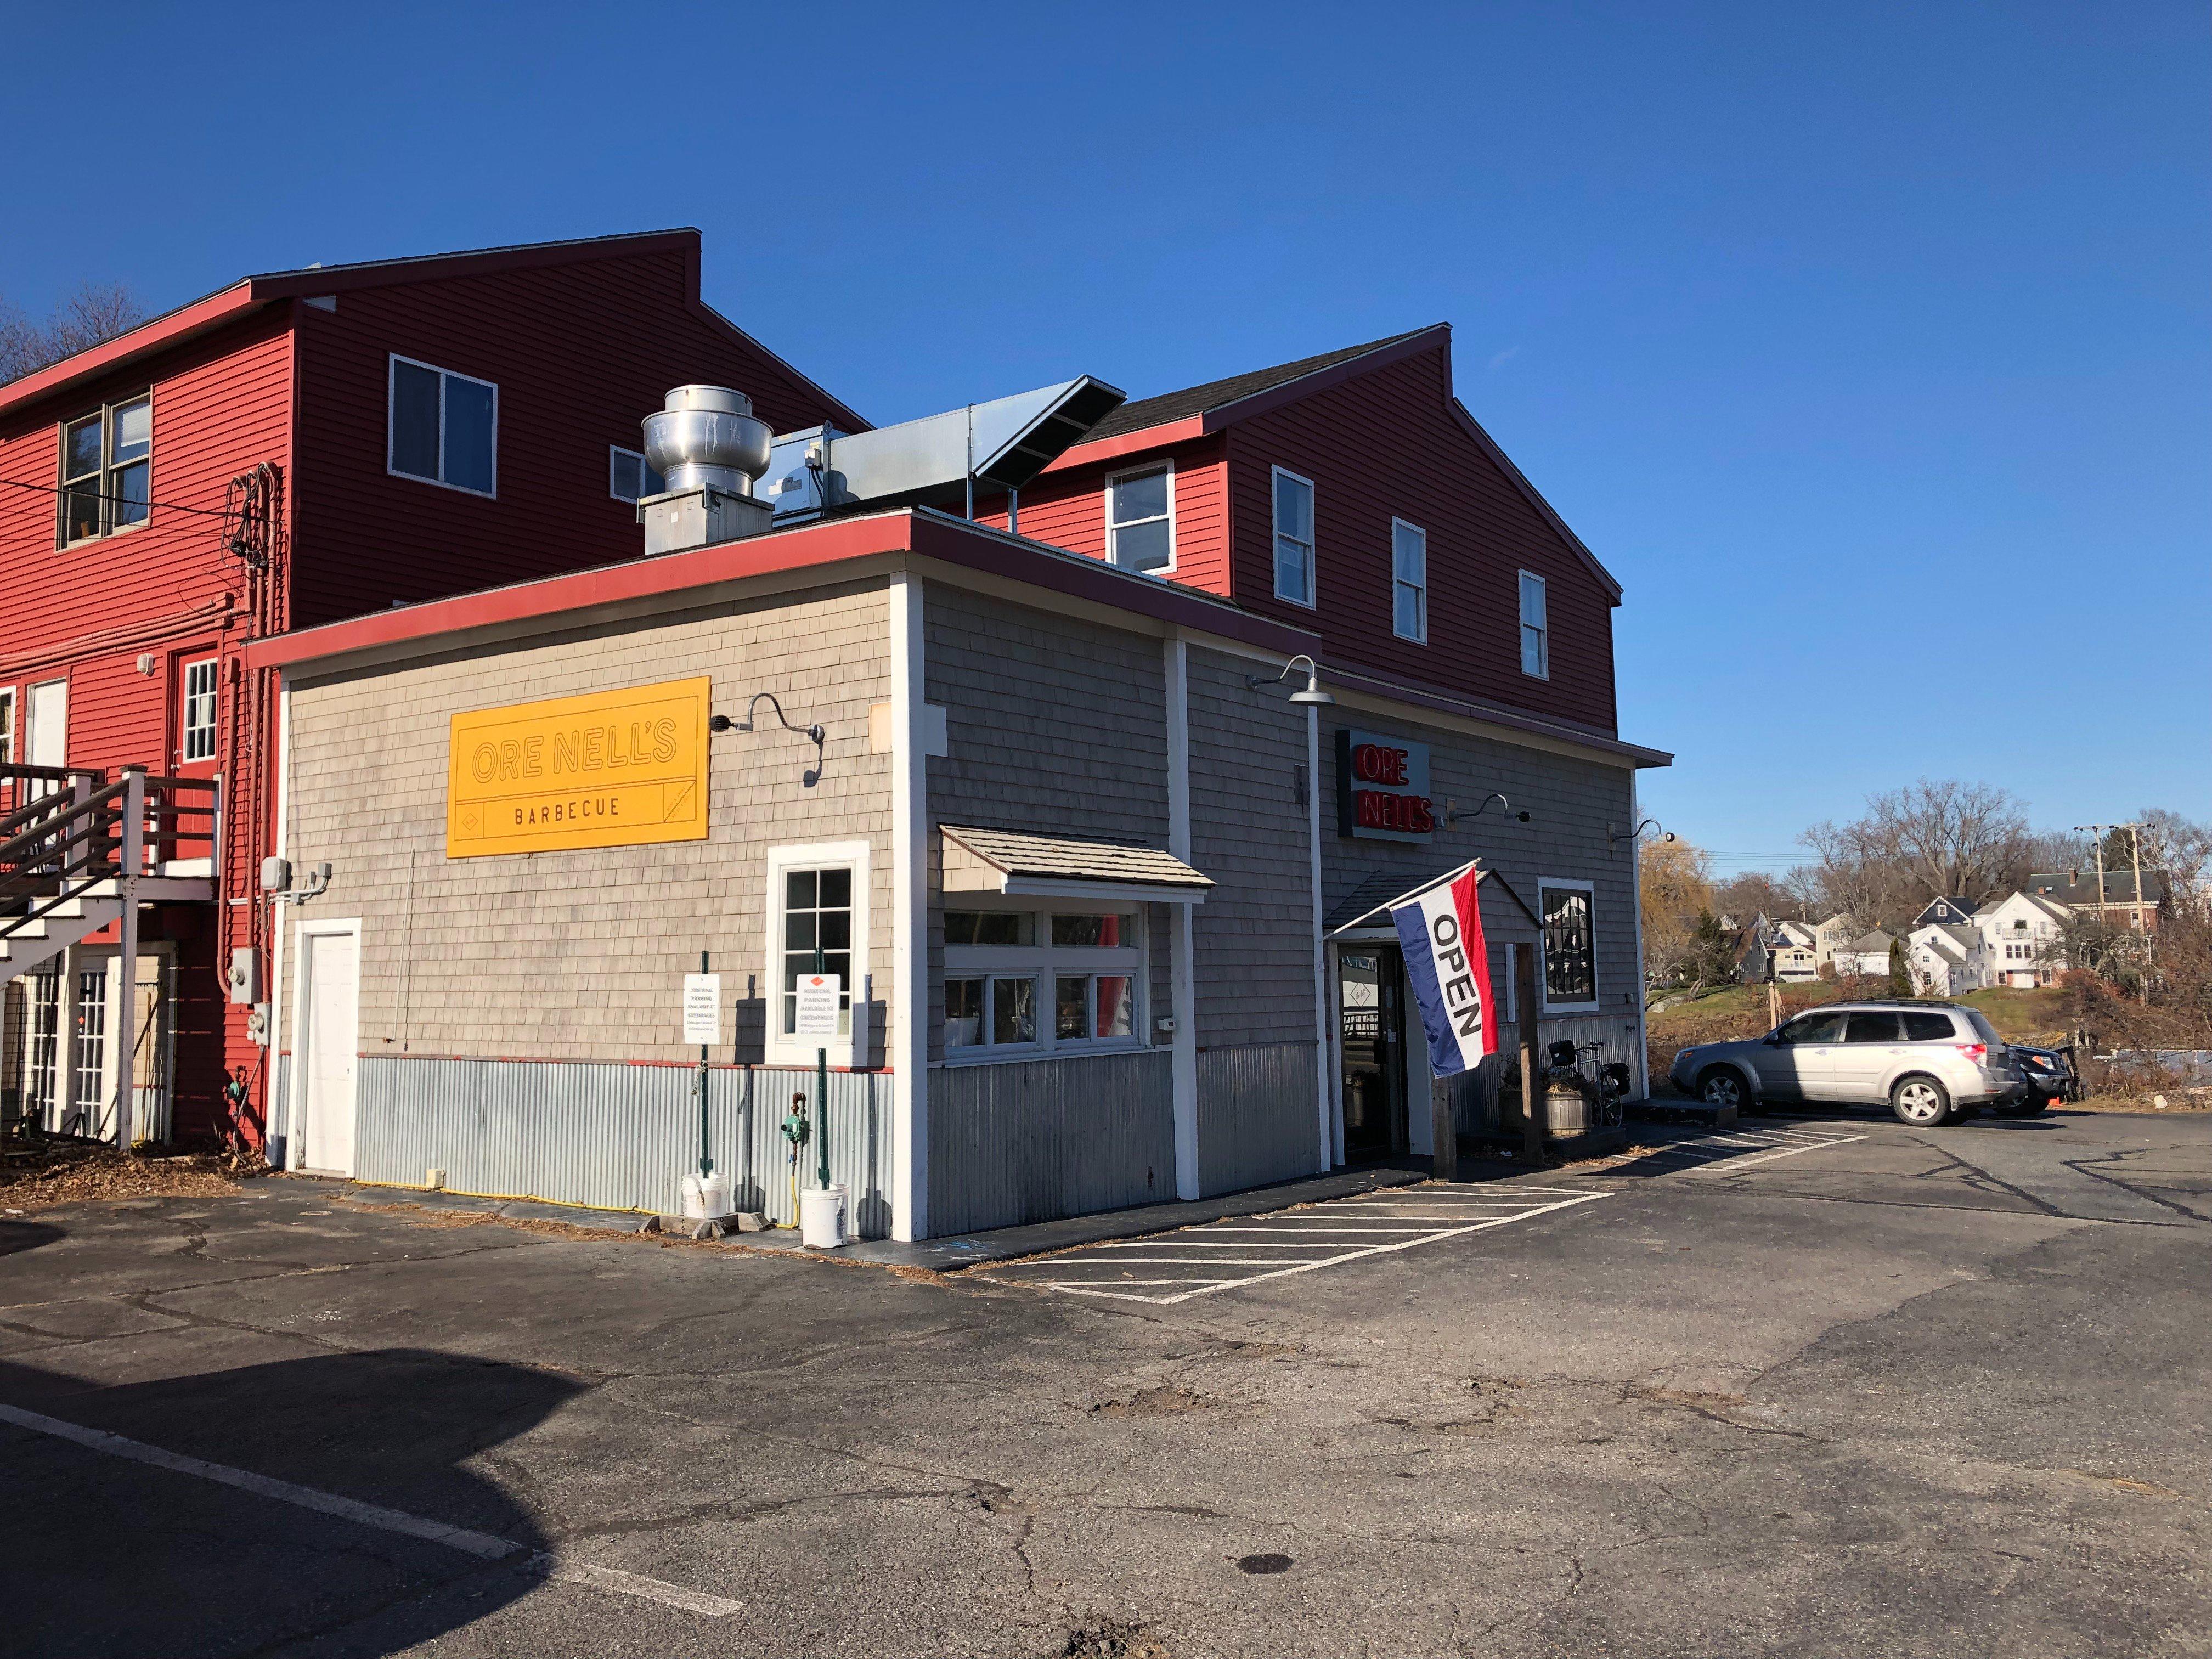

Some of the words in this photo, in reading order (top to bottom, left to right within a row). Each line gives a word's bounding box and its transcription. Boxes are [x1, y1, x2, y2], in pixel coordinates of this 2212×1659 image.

[472, 735, 544, 783] ORE
[553, 718, 677, 775] NELL'S
[1357, 743, 1409, 786] ORE
[515, 798, 619, 825] BARBECUE
[1434, 913, 1482, 1037] OPEN
